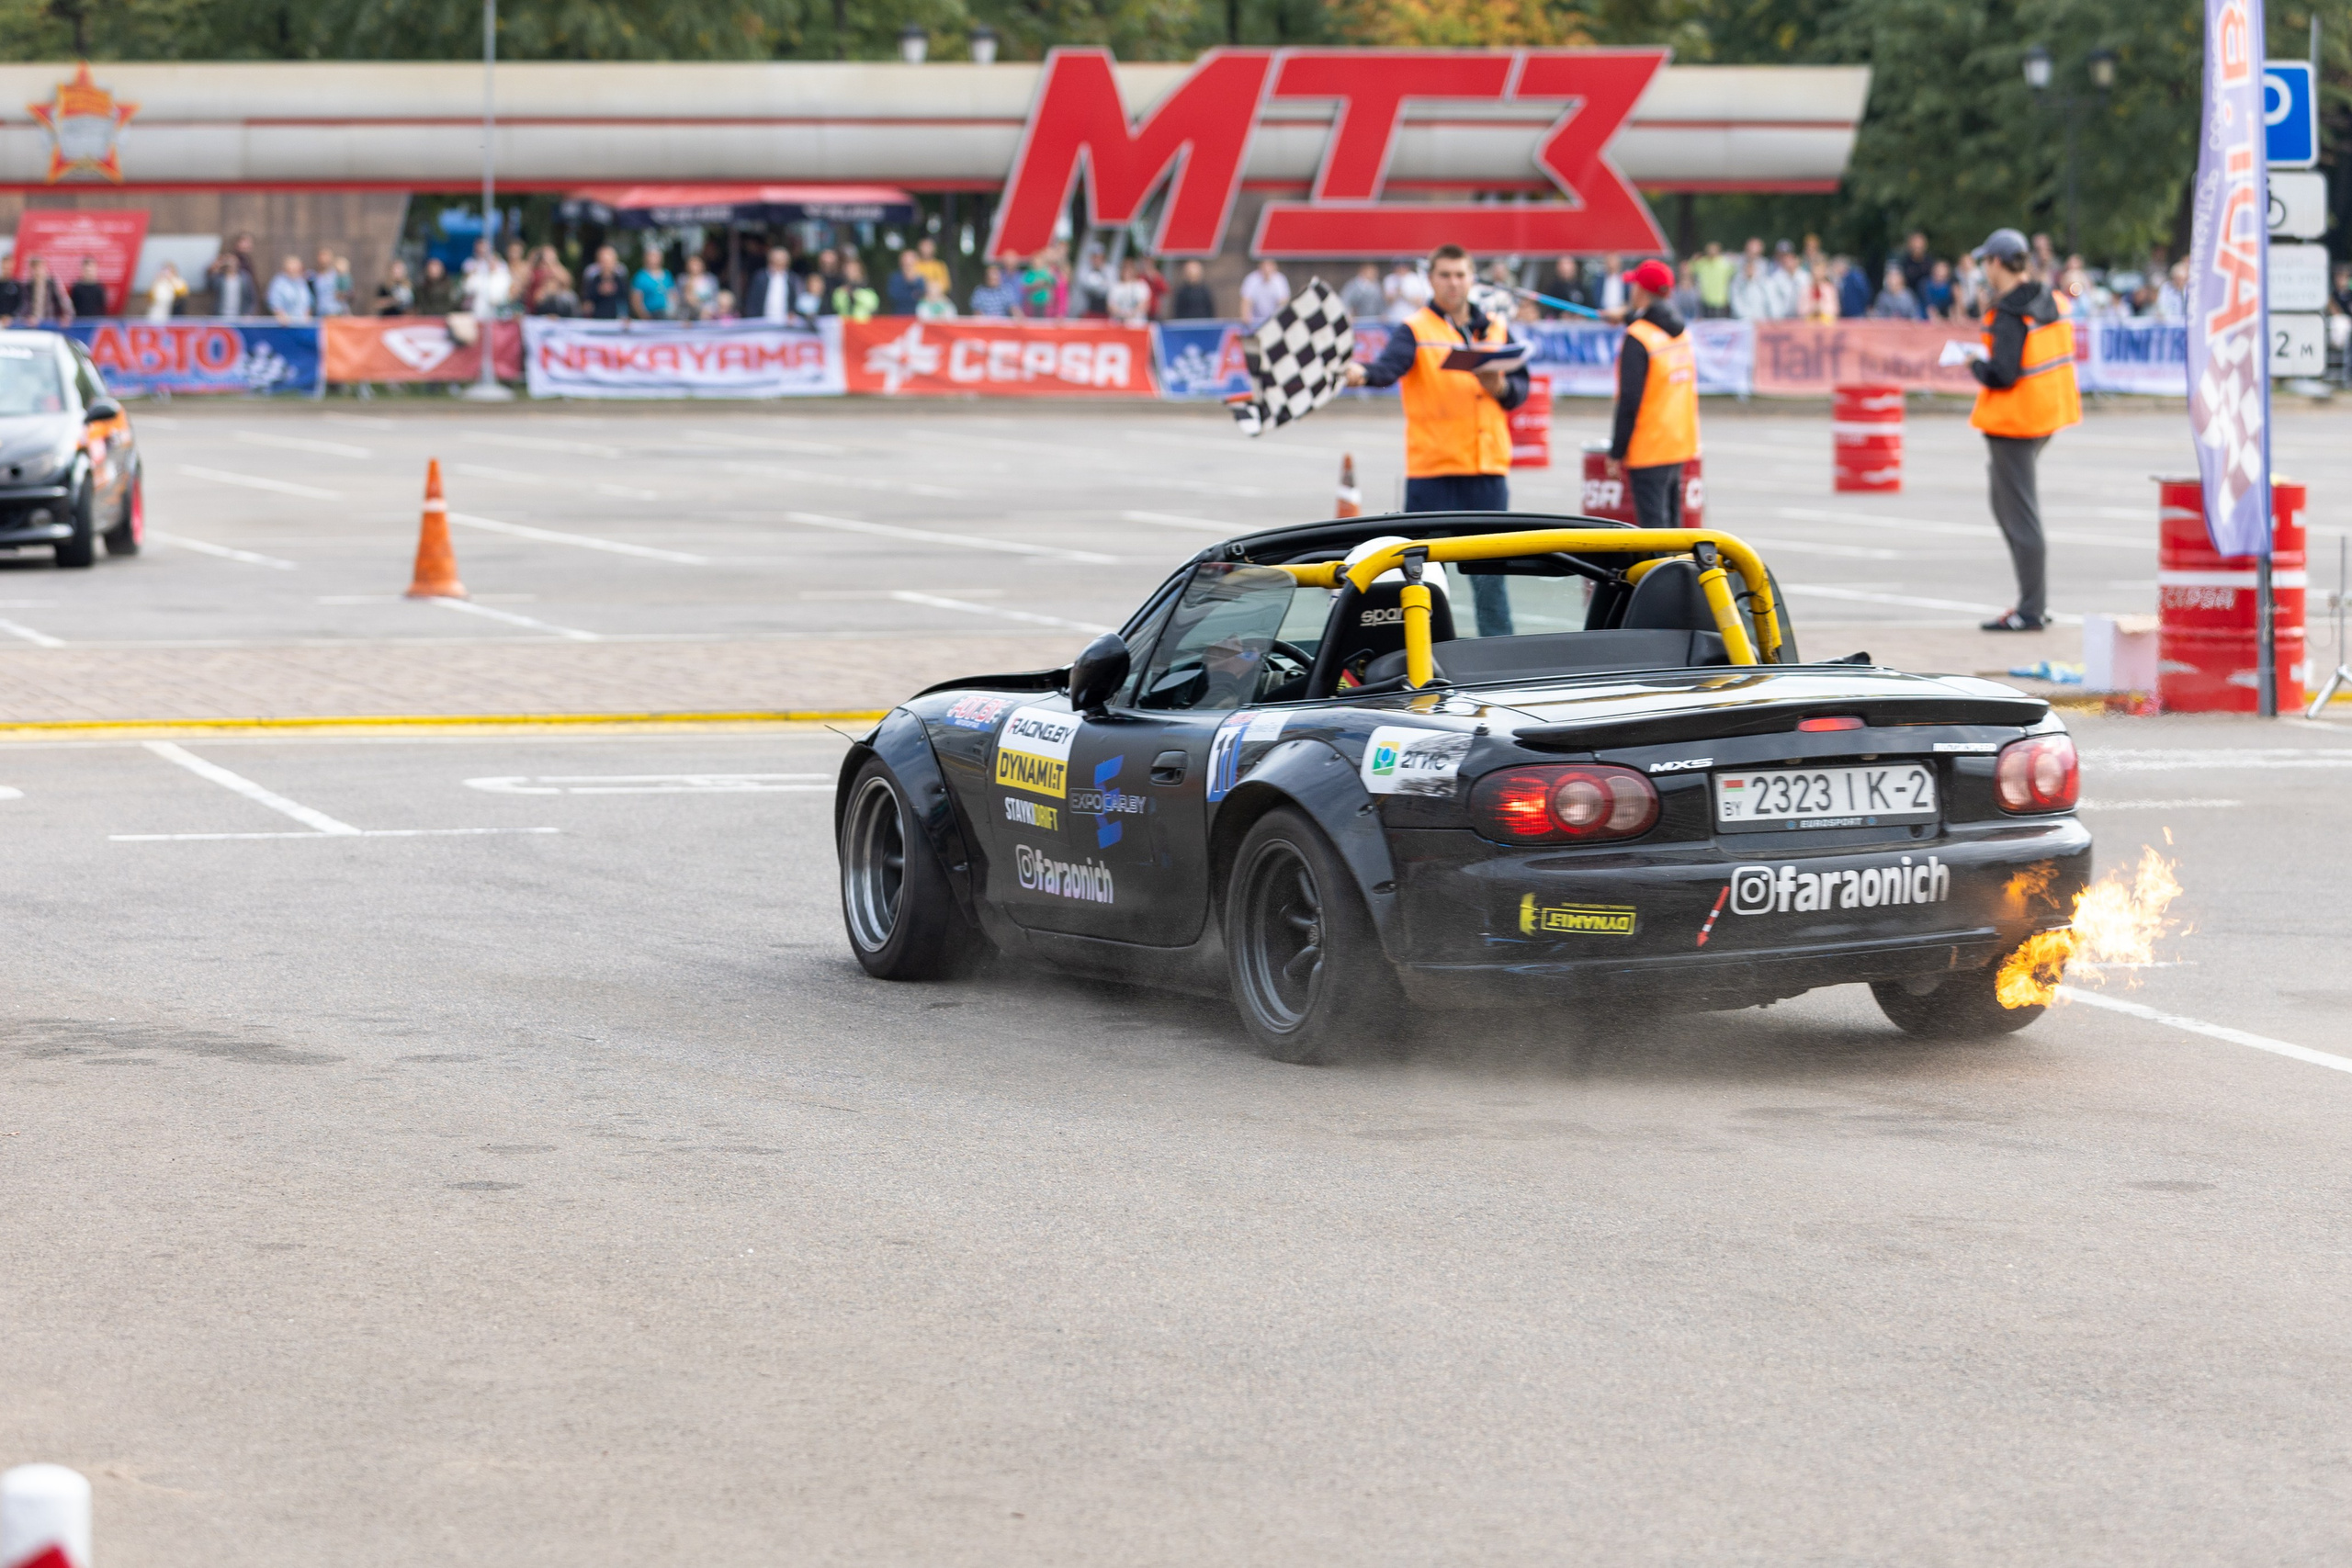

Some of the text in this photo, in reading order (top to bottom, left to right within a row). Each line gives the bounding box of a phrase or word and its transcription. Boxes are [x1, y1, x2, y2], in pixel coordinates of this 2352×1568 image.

[987, 47, 1668, 258] МТЗ
[538, 339, 825, 373] NAKAYAMA
[948, 337, 1132, 387] CEPSA
[1360, 607, 1404, 626] spar
[1724, 801, 1743, 816] BY
[1751, 774, 1831, 815] 2323
[1800, 817, 1863, 828] EUROSPORT
[1035, 850, 1114, 904] faraonich
[1777, 856, 1951, 912] faraonich
